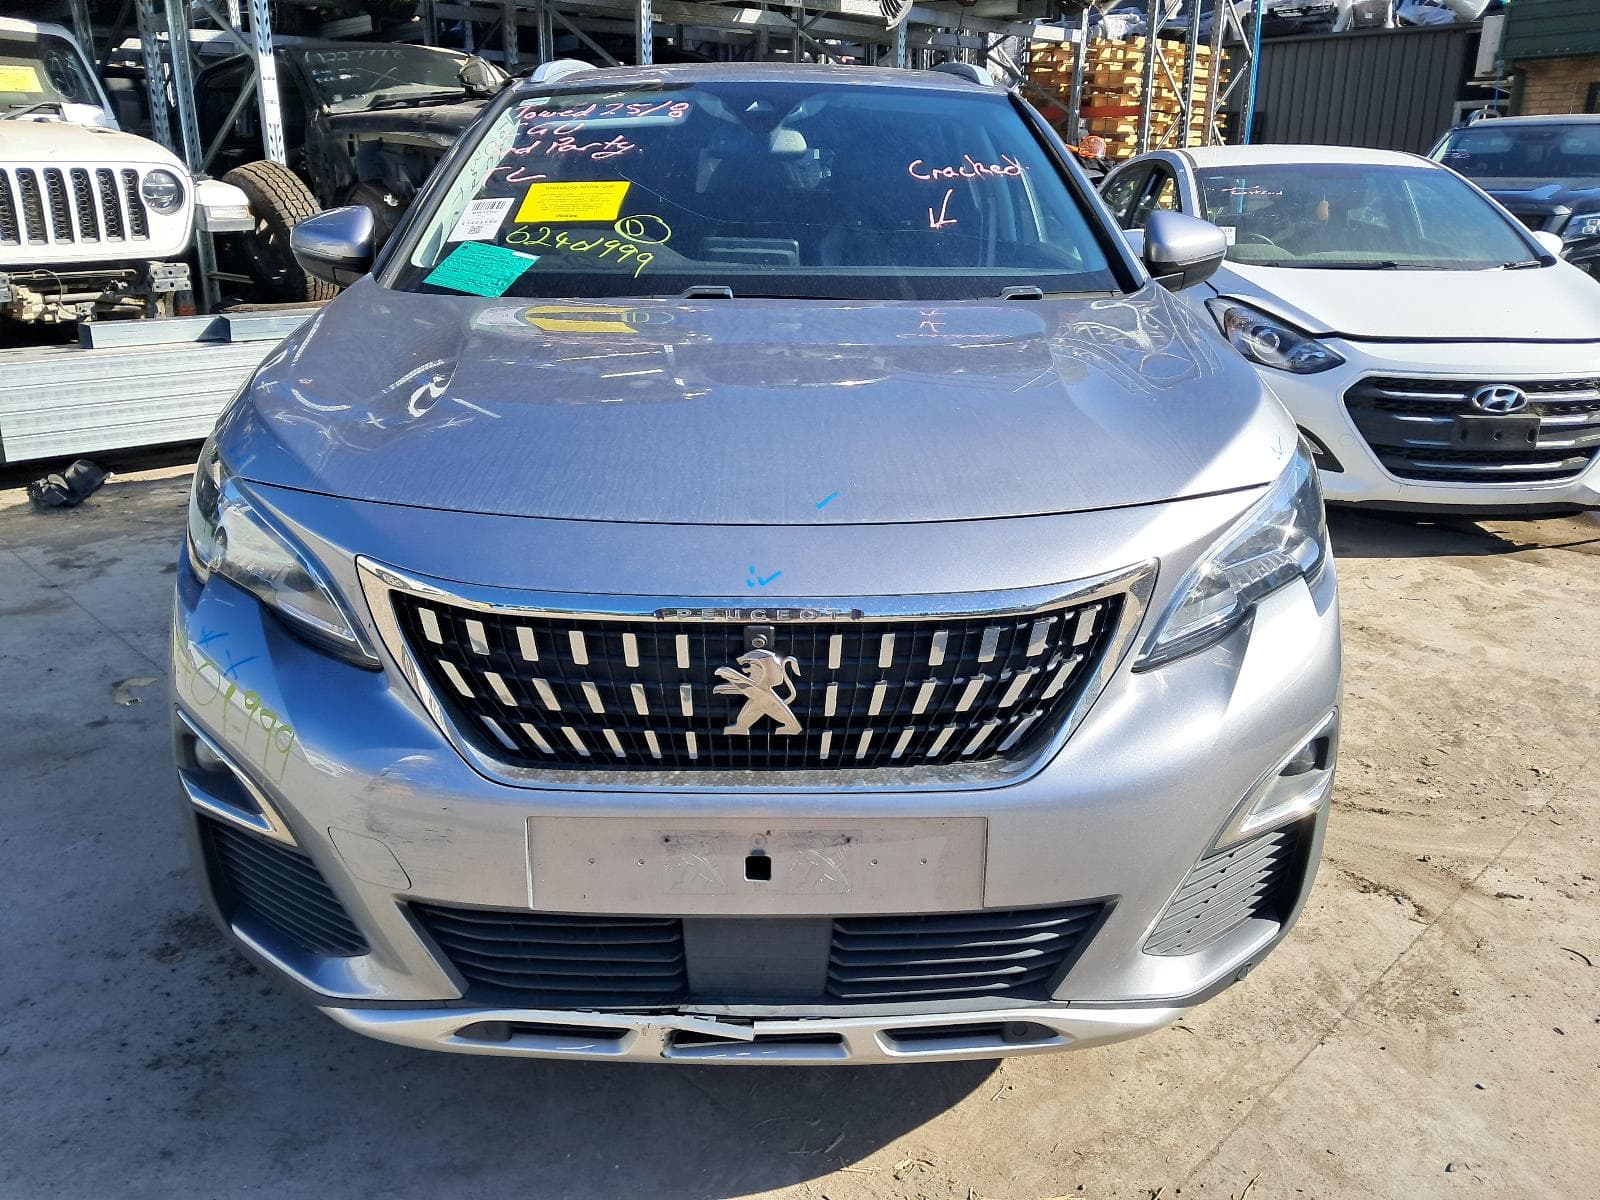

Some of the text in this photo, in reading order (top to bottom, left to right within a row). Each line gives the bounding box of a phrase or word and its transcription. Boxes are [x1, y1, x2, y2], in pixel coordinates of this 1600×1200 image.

[514, 100, 690, 119] Towed 25/8
[908, 154, 1022, 180] Cracked
[676, 608, 842, 621] PEUGEOT
